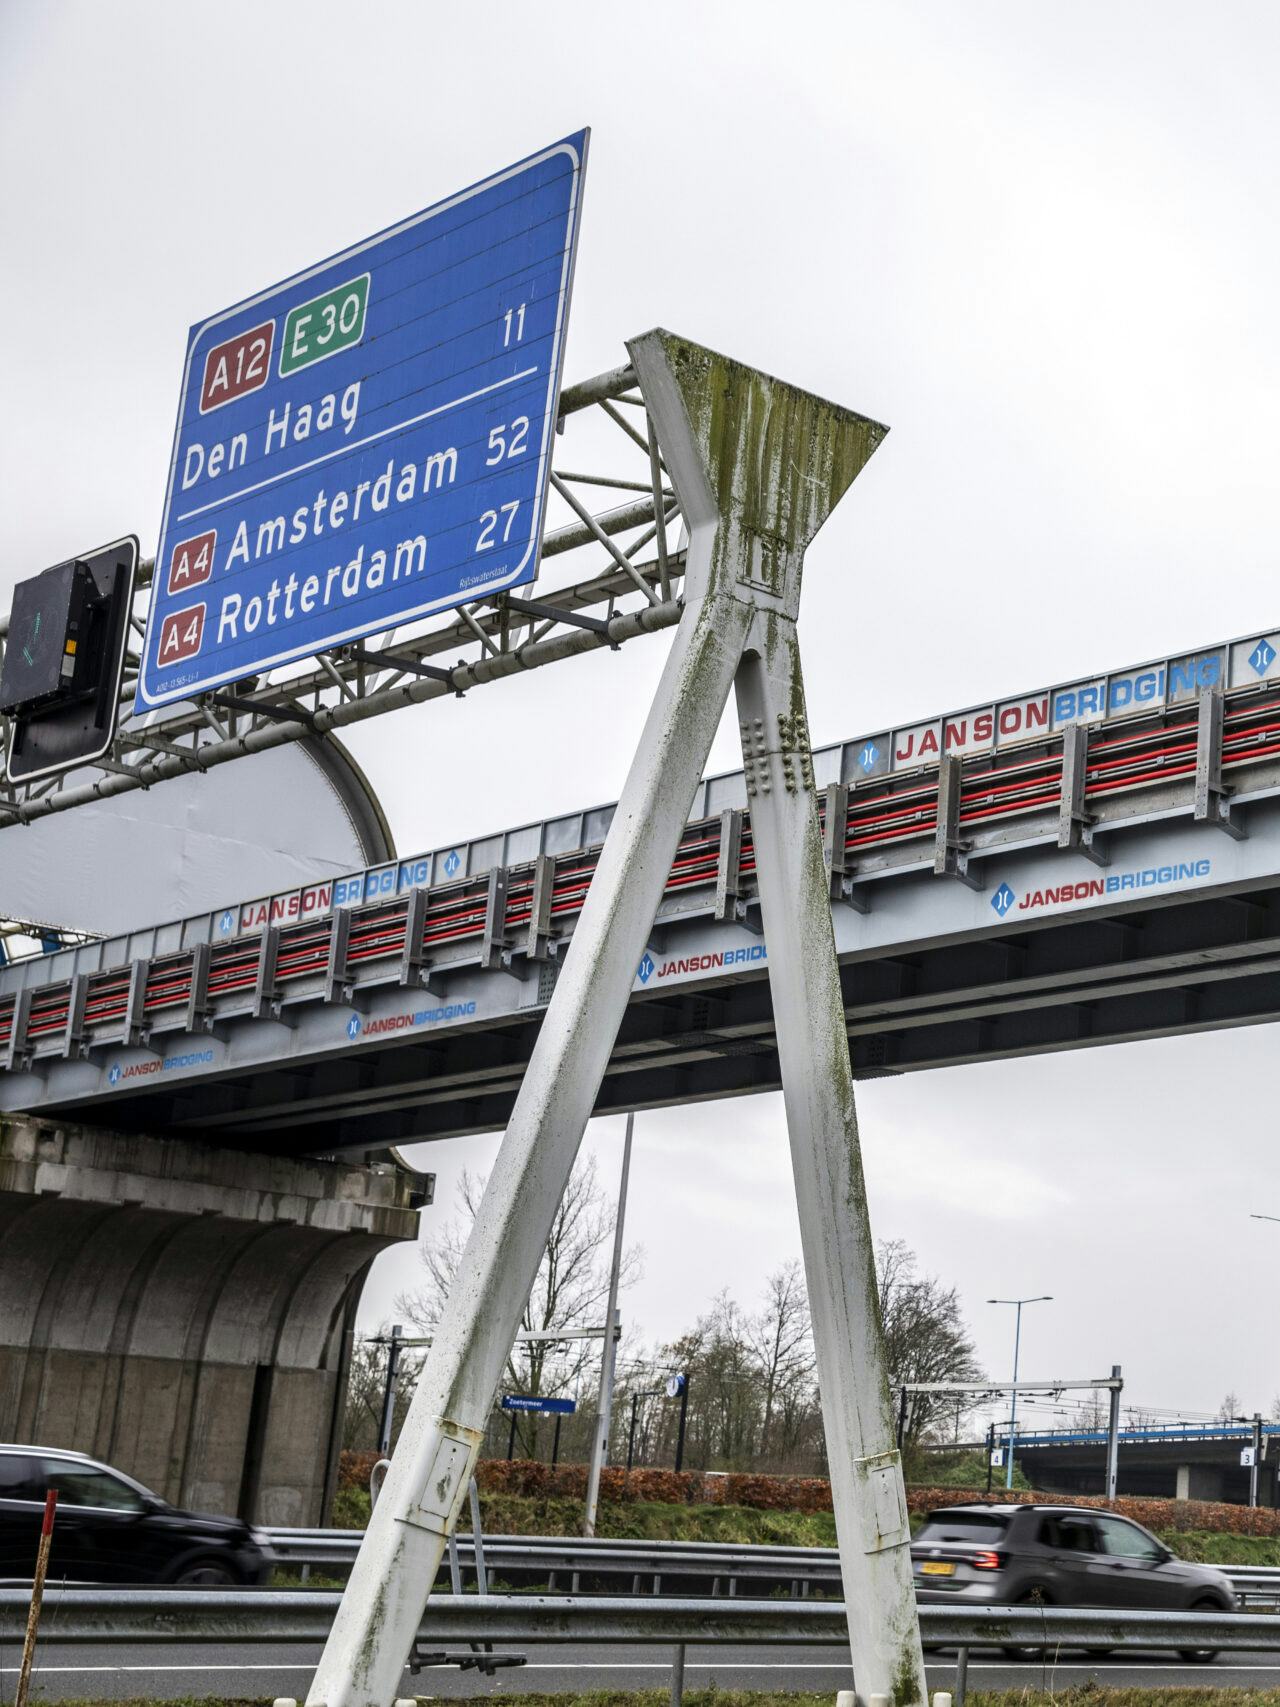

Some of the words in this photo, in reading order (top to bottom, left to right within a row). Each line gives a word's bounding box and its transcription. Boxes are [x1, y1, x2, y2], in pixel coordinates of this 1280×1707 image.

[182, 434, 248, 490] Den
[265, 381, 361, 455] Haag
[503, 303, 526, 347] 11
[208, 338, 266, 398] A12
[291, 293, 360, 358] E30
[224, 446, 458, 571] Amsterdam
[485, 415, 529, 466] 52
[174, 542, 210, 583] A4
[217, 534, 427, 644] Rotterdam
[475, 500, 520, 552] 27
[163, 615, 199, 656] A4
[994, 1455, 999, 1464] 4
[1244, 1454, 1250, 1464] 3
